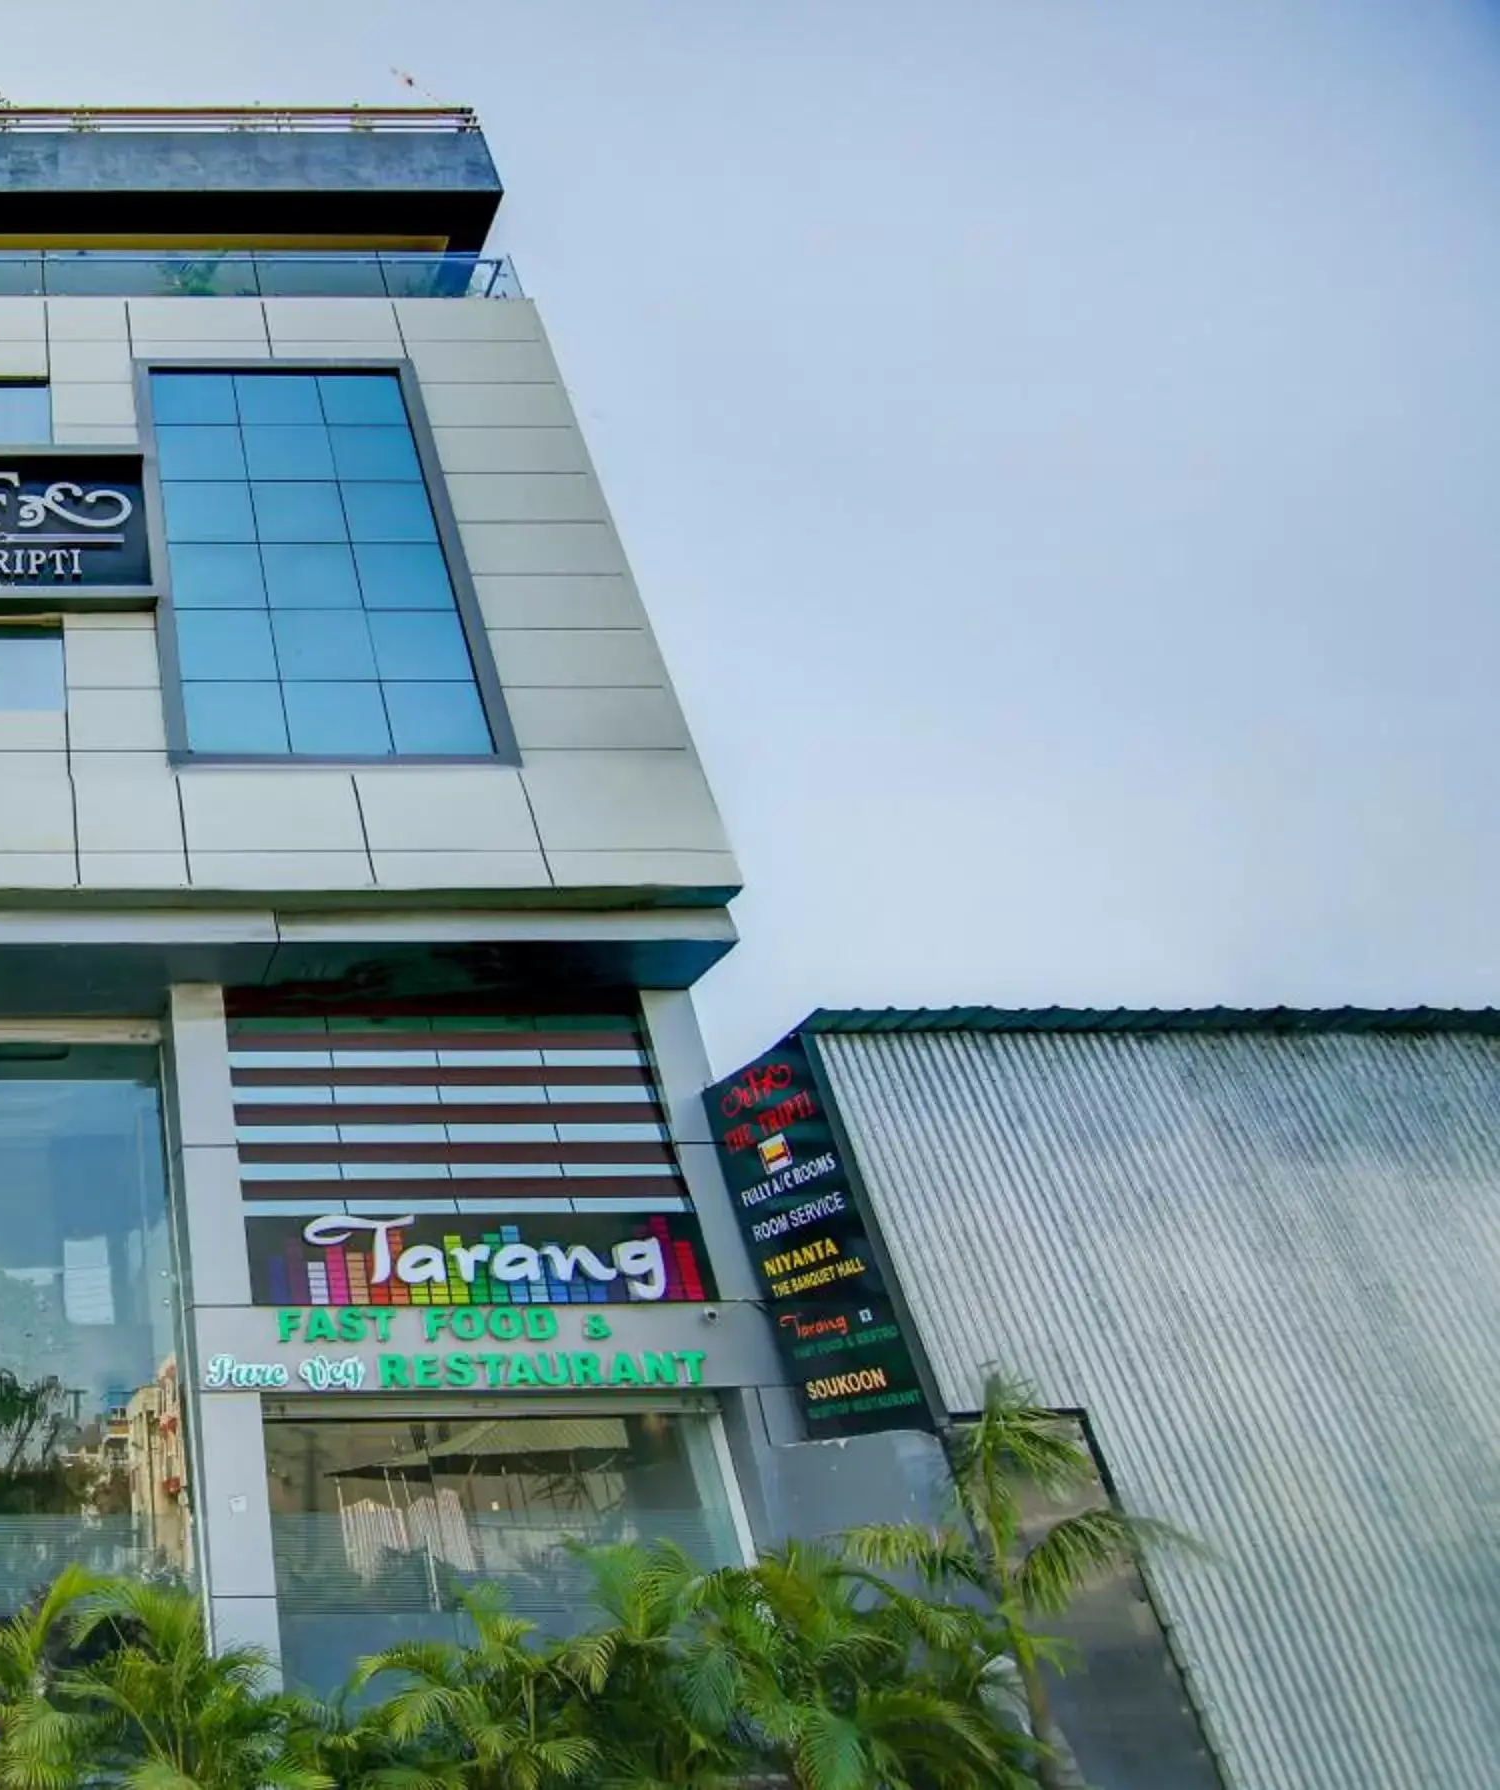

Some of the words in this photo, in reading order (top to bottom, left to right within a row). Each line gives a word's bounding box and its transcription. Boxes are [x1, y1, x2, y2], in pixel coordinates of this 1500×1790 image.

[741, 1180, 772, 1207] FULLY
[771, 1171, 794, 1194] A/C
[792, 1152, 836, 1185] ROOMS
[752, 1213, 791, 1242] ROOM
[789, 1191, 845, 1228] SERVICE
[303, 1214, 669, 1300] Tarang
[763, 1237, 840, 1278] NIYANTA
[772, 1280, 792, 1297] THE
[790, 1266, 836, 1293] BANQUET
[835, 1256, 866, 1277] HALL
[278, 1306, 396, 1342] FAST
[424, 1306, 559, 1342] FOOD
[583, 1313, 612, 1341] &
[205, 1353, 290, 1390] Pure
[299, 1354, 368, 1391] Veg
[377, 1349, 707, 1389] RESTAURANT
[804, 1368, 888, 1400] SOUKOON
